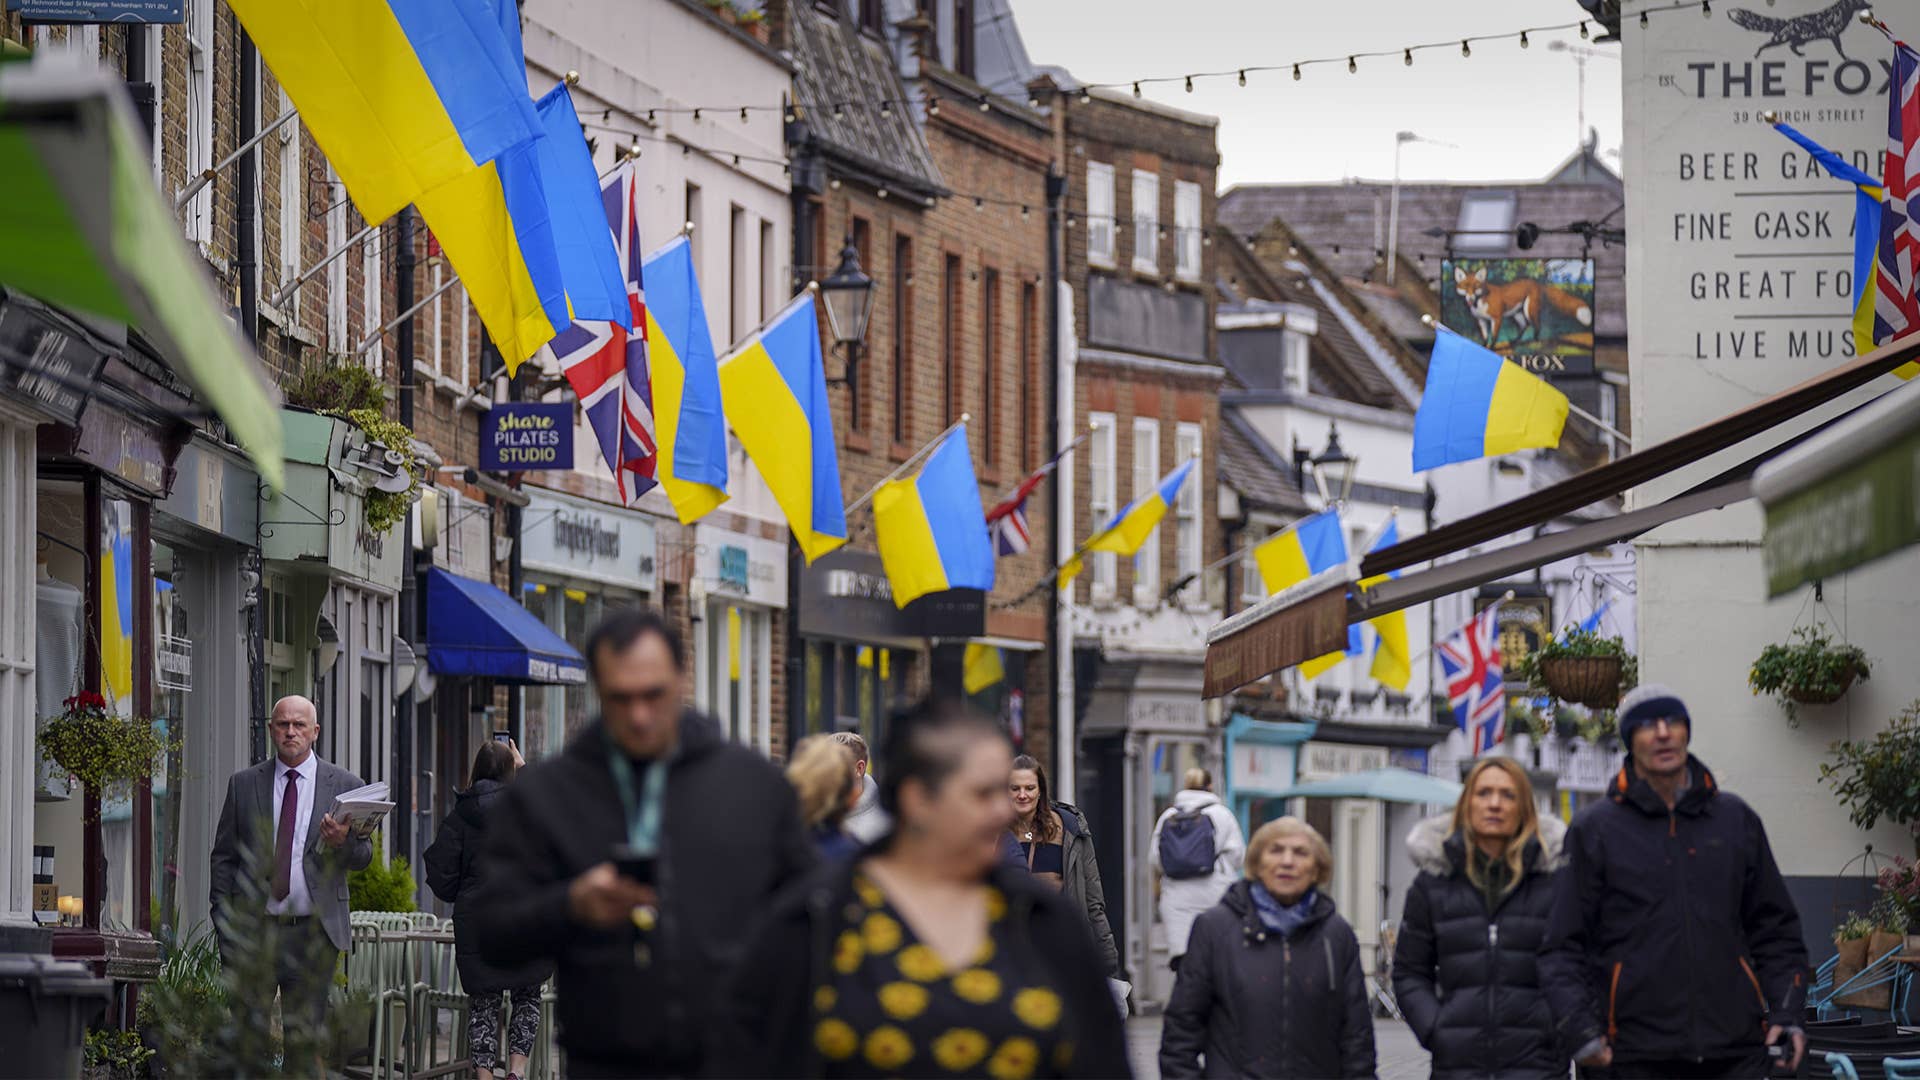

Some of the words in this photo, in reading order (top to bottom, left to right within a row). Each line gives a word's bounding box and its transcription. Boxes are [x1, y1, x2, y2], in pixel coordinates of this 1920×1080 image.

[1688, 61, 1786, 98] THE
[1733, 111, 1749, 123] 39
[1756, 110, 1811, 123] CURCH
[1818, 109, 1864, 122] STREET
[1680, 153, 1758, 180] BEER
[1781, 150, 1886, 179] GADE
[1675, 213, 1732, 241] FINE
[1755, 211, 1832, 239] CASK
[1691, 271, 1796, 299] GREAT
[1696, 331, 1766, 359] LIVE
[1521, 354, 1565, 371] FOX
[499, 412, 555, 432] share
[494, 431, 559, 446] PILATES
[499, 447, 556, 463] STUDIO
